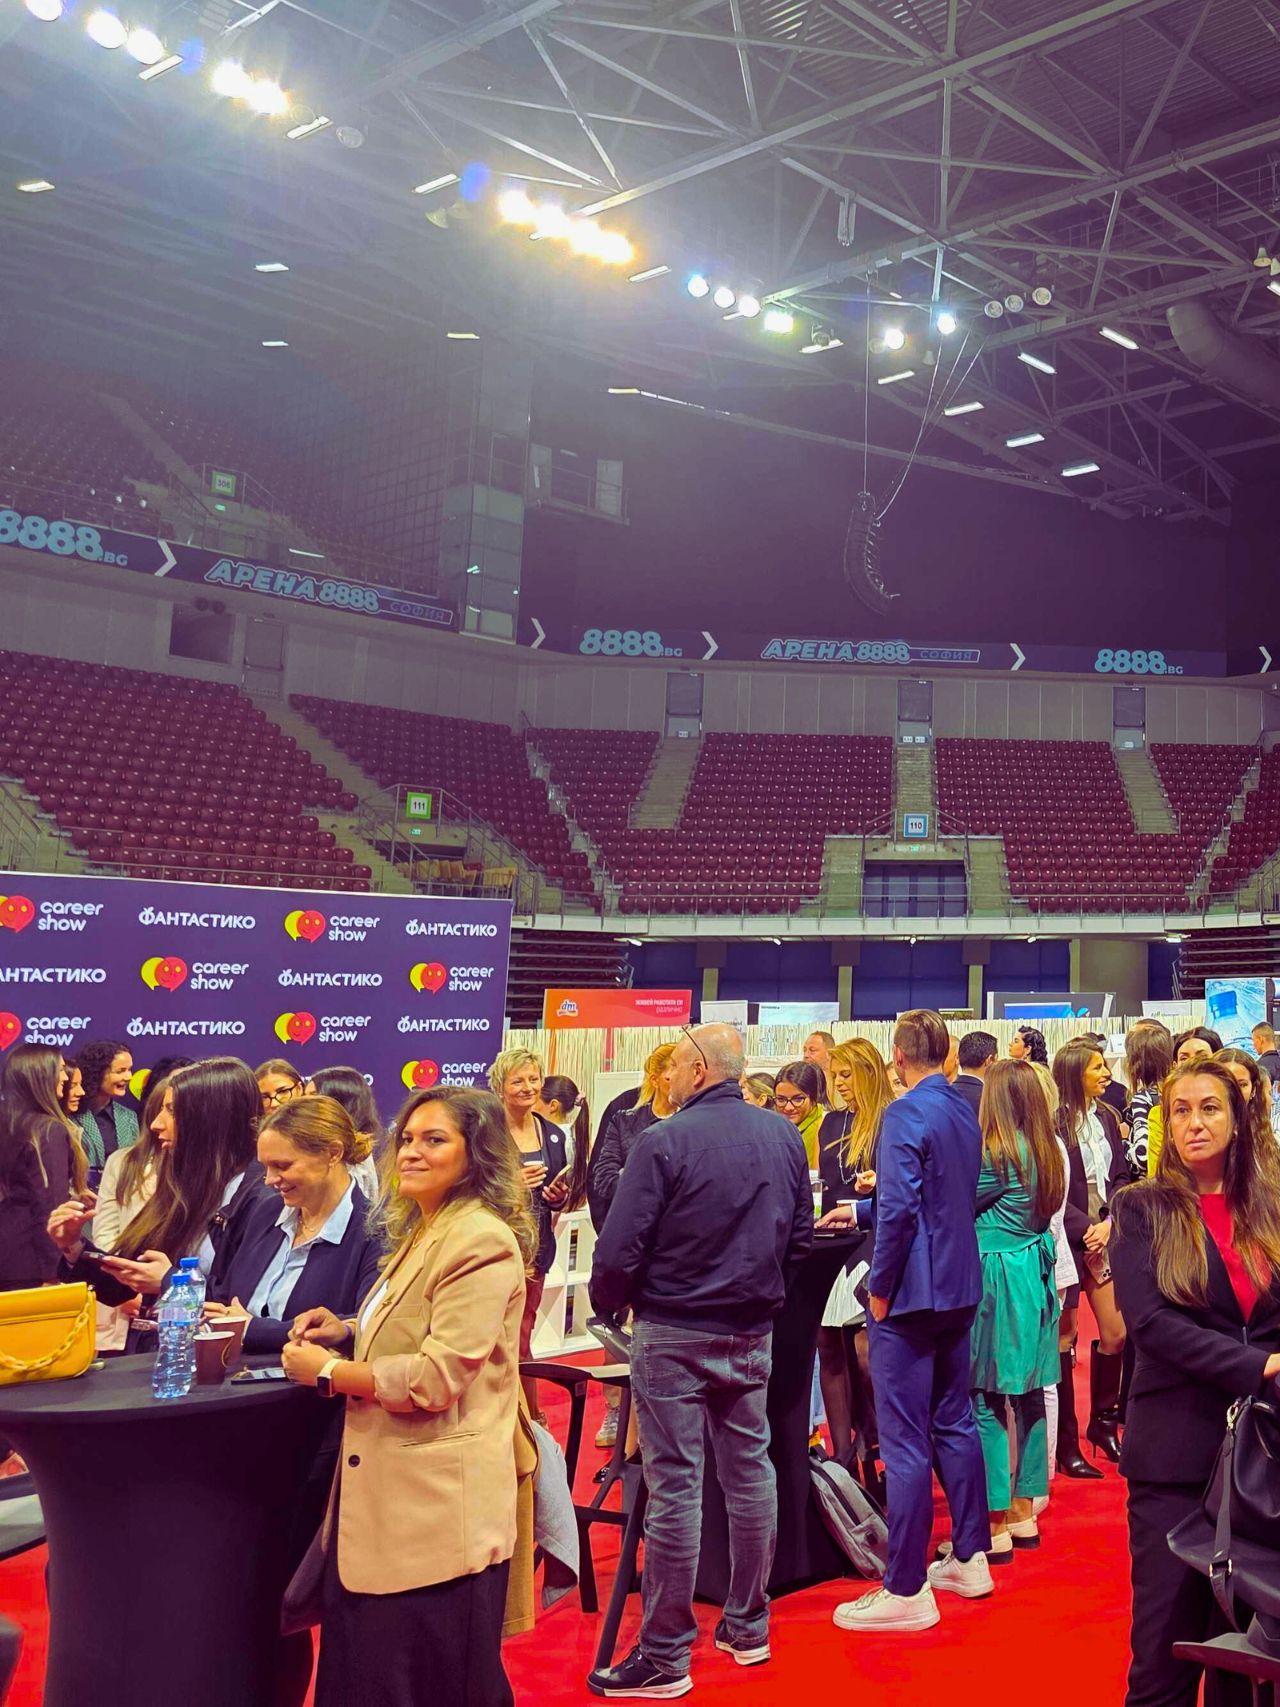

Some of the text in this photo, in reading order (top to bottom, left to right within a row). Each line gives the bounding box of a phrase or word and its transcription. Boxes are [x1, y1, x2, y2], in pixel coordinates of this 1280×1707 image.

[206, 560, 445, 621] АРЕНА 8888 СОФИЯ
[579, 628, 683, 657] 8888.BG
[763, 639, 973, 662] АРЕНА 8888 СОФИЯ
[1095, 648, 1184, 675] 8888.BG
[413, 801, 425, 811] 111
[40, 901, 104, 916] career
[38, 914, 86, 931] show
[138, 906, 256, 929] ФАНТАСТИКО
[329, 915, 380, 928] career
[328, 928, 367, 942] show
[405, 919, 498, 937] ФАНТАСТИКО
[192, 962, 250, 975] career
[449, 966, 494, 978] career
[190, 974, 234, 990] show
[278, 968, 383, 987] ФАНТАСТИКО
[448, 977, 482, 992] show
[27, 1017, 91, 1029] career
[127, 1017, 245, 1037] ФАНТАСТИКО
[320, 1015, 372, 1028] career
[397, 1015, 490, 1034] ФАНТАСТИКО
[25, 1029, 74, 1046] show
[318, 1028, 358, 1042] show
[442, 1063, 487, 1074] career
[441, 1074, 475, 1087] show
